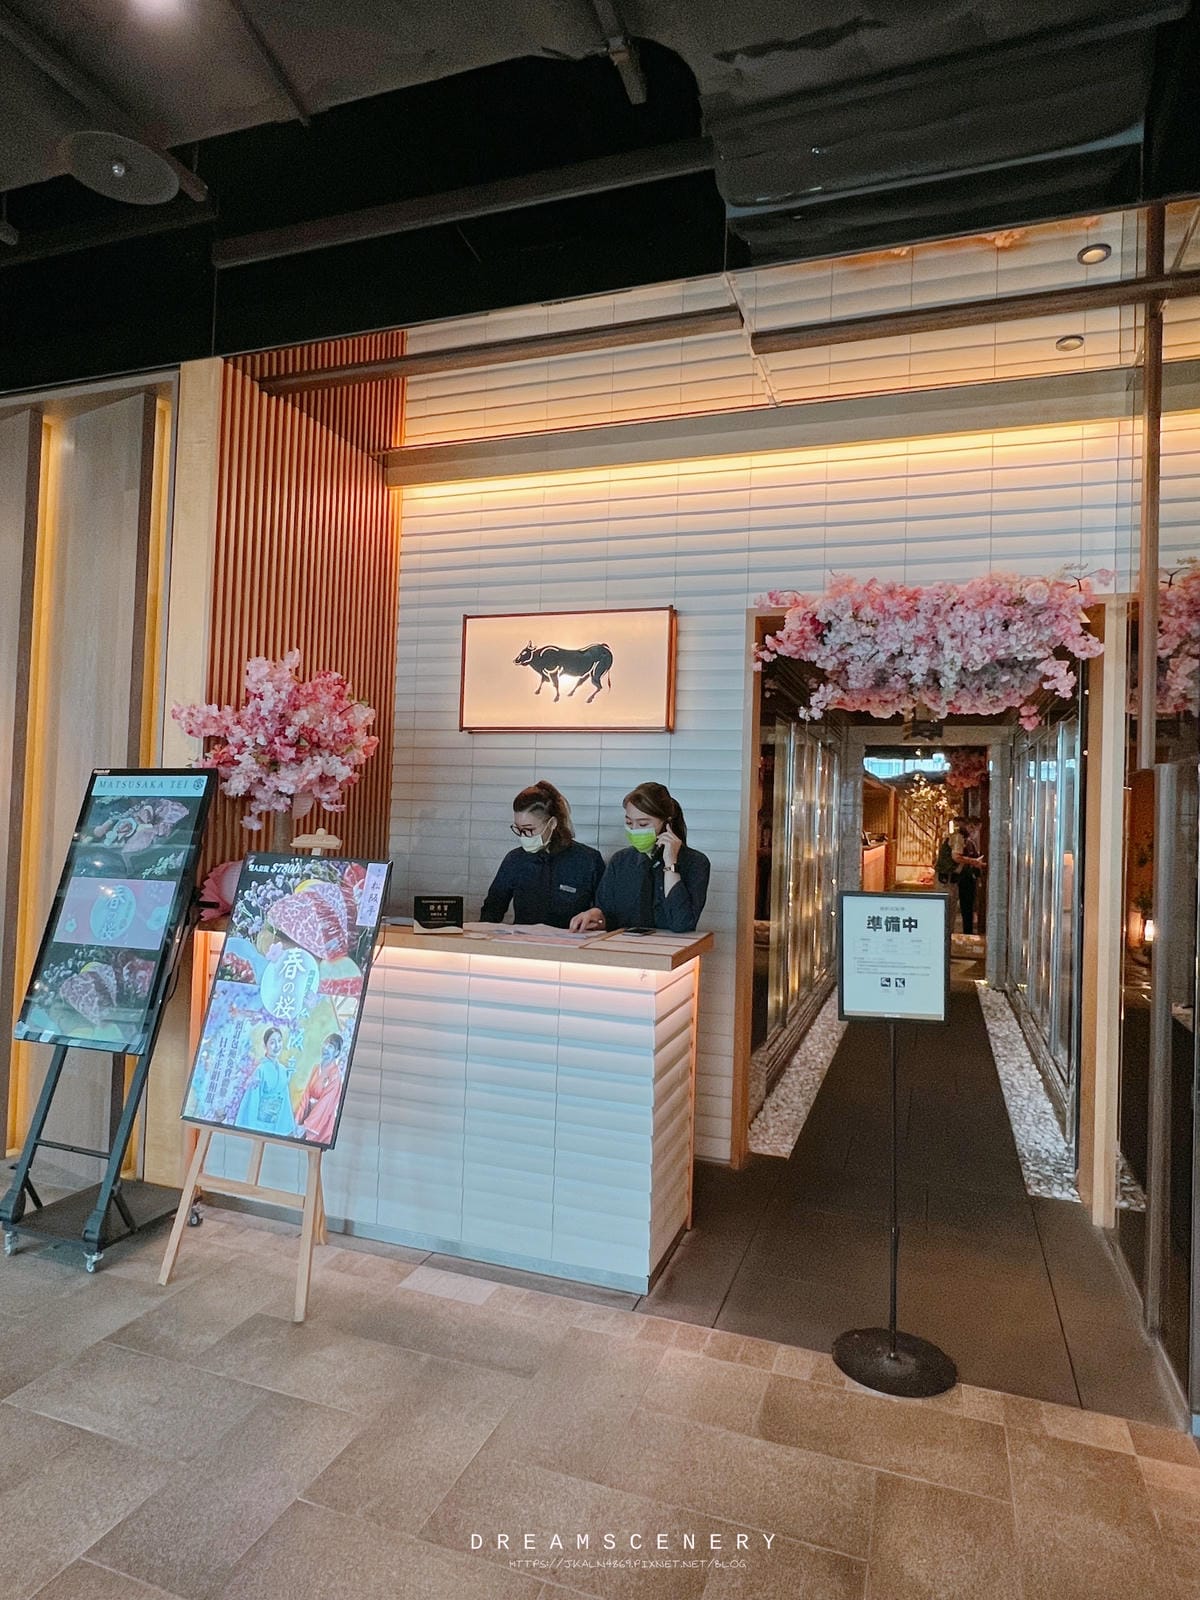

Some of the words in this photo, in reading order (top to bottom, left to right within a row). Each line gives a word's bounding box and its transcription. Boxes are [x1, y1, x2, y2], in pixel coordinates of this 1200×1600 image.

[99, 780, 164, 789] MATSUSAKA
[170, 780, 188, 789] TEI
[866, 915, 919, 933] 準備中
[272, 946, 306, 1020] 春の桜
